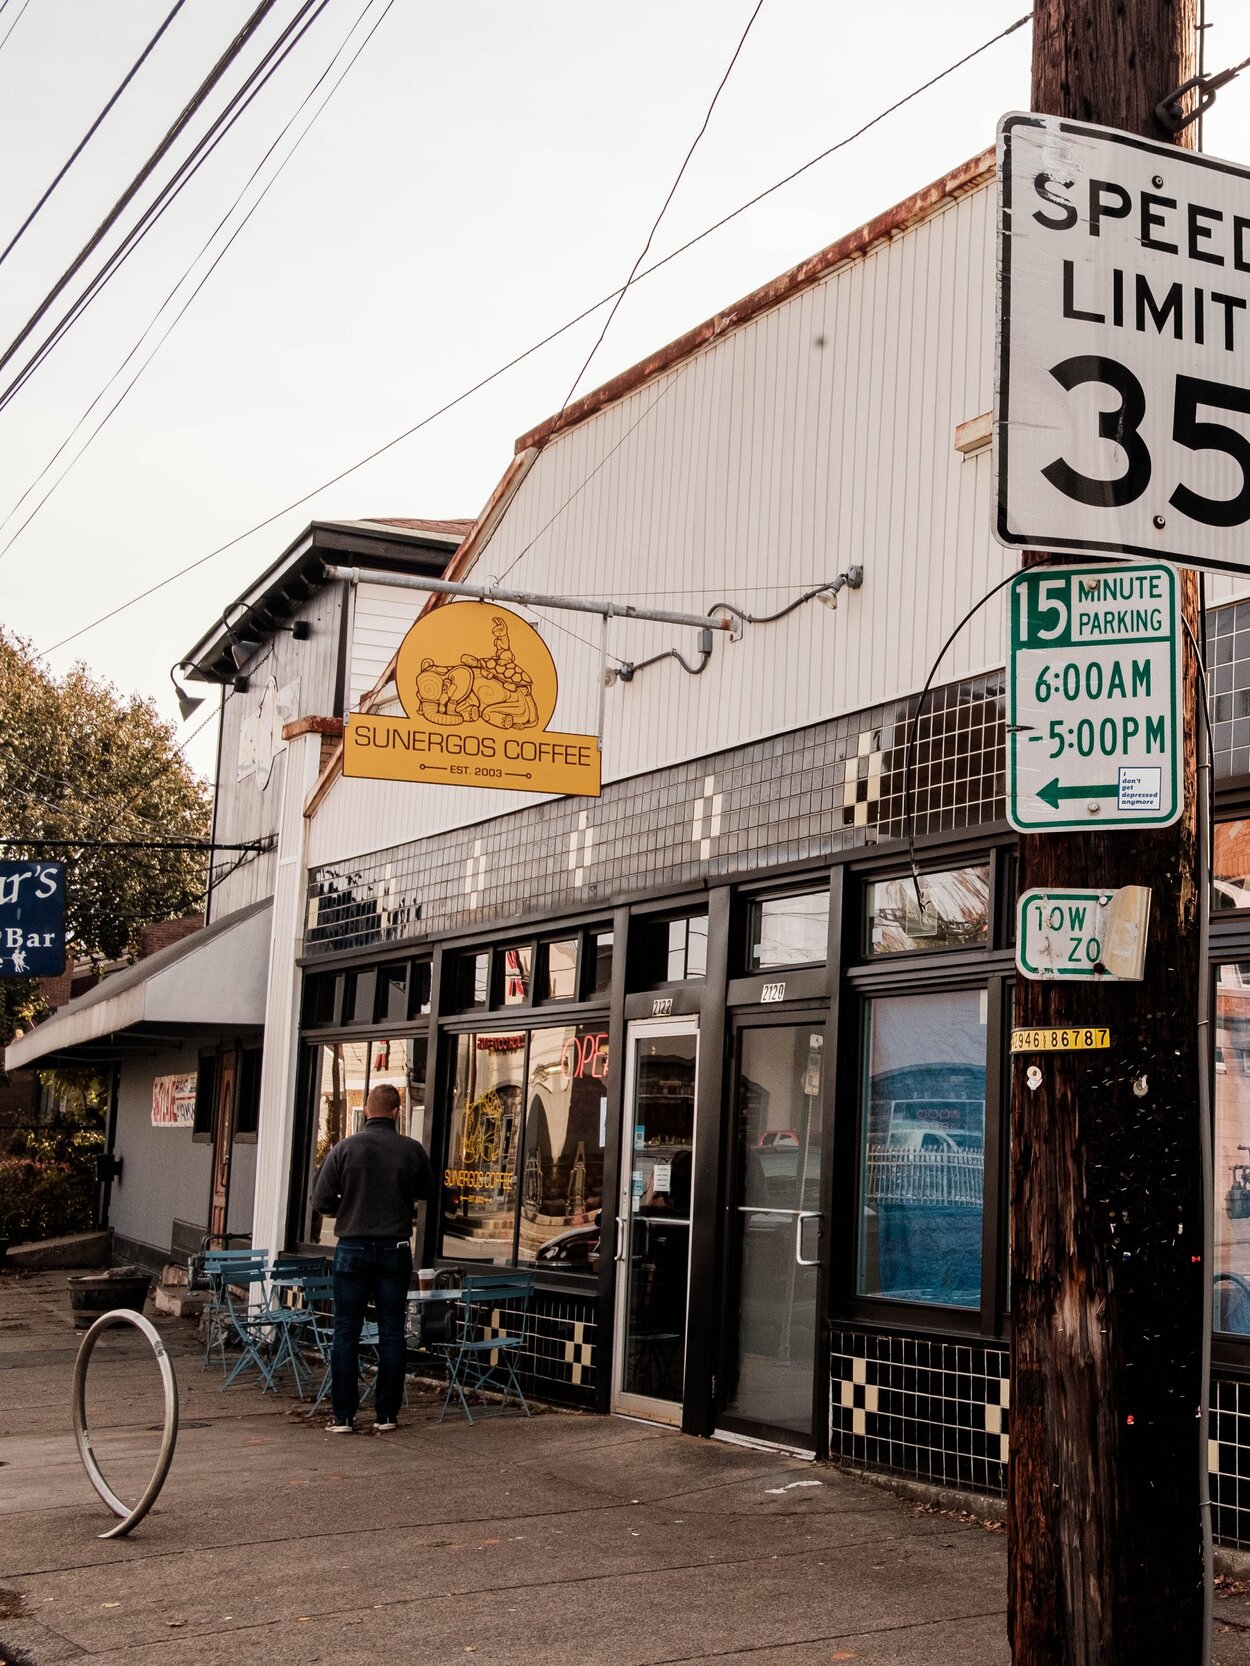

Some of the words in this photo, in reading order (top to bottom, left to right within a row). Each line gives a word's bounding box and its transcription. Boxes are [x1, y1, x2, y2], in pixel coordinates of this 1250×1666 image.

[1063, 259, 1247, 351] LIMIT
[1015, 579, 1069, 642] 15
[1078, 575, 1163, 602] MINUTE
[1079, 608, 1162, 636] PARKING
[1035, 658, 1151, 703] 6:00AM
[354, 725, 496, 758] SUNERGOS
[504, 739, 591, 767] COFFEE
[450, 765, 472, 776] EST.
[474, 767, 503, 778] 2003
[5, 927, 56, 948] Bar
[762, 984, 785, 1001] 2120
[653, 1000, 672, 1015] 2122
[561, 1032, 608, 1079] OPE
[444, 1169, 484, 1189] SUNERGOS
[484, 1171, 513, 1190] COFFEE
